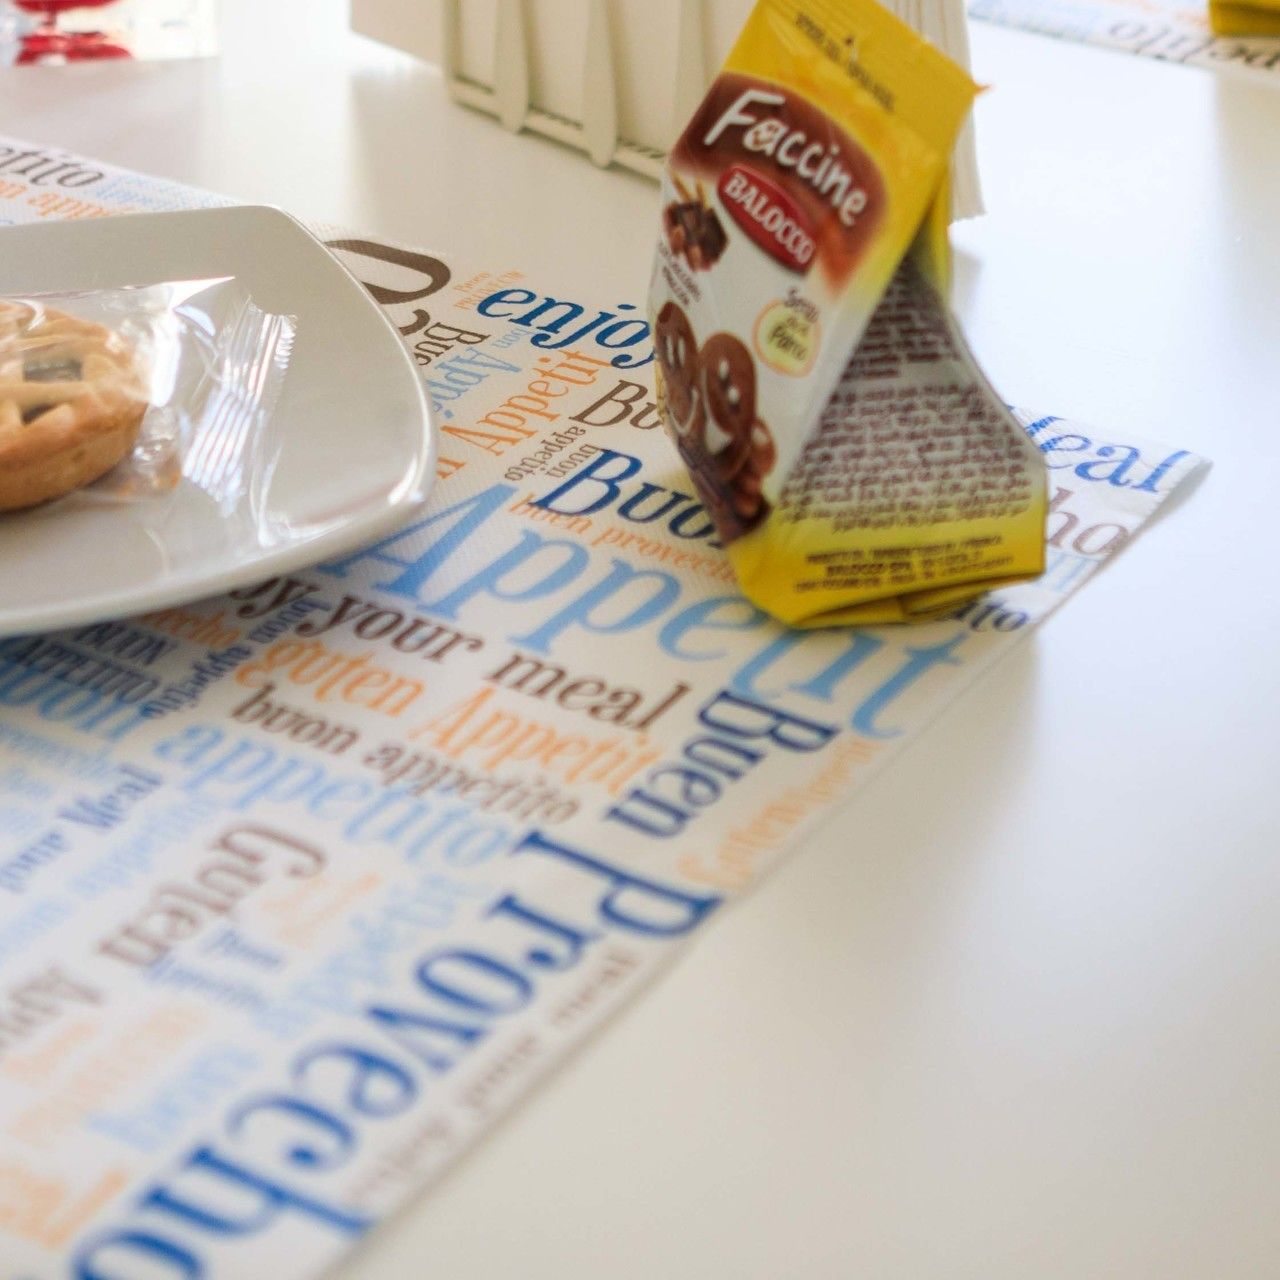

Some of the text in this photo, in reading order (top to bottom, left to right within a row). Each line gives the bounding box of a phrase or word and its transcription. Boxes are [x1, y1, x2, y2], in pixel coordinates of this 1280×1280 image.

[704, 89, 869, 227] Faccine
[725, 173, 816, 266] BALOCCO
[414, 321, 492, 367] Bue
[440, 348, 614, 457] Appetit
[569, 379, 666, 430] Bu
[504, 425, 587, 482] appetito
[527, 447, 724, 553] Buo
[546, 442, 604, 480] buon
[298, 595, 484, 663] your
[482, 652, 693, 733] meal
[318, 481, 969, 740] Appetit
[231, 683, 583, 825] buon appetito
[235, 639, 667, 795] guten Appetit
[604, 689, 844, 841] Buen
[65, 827, 724, 1280] Provecho
